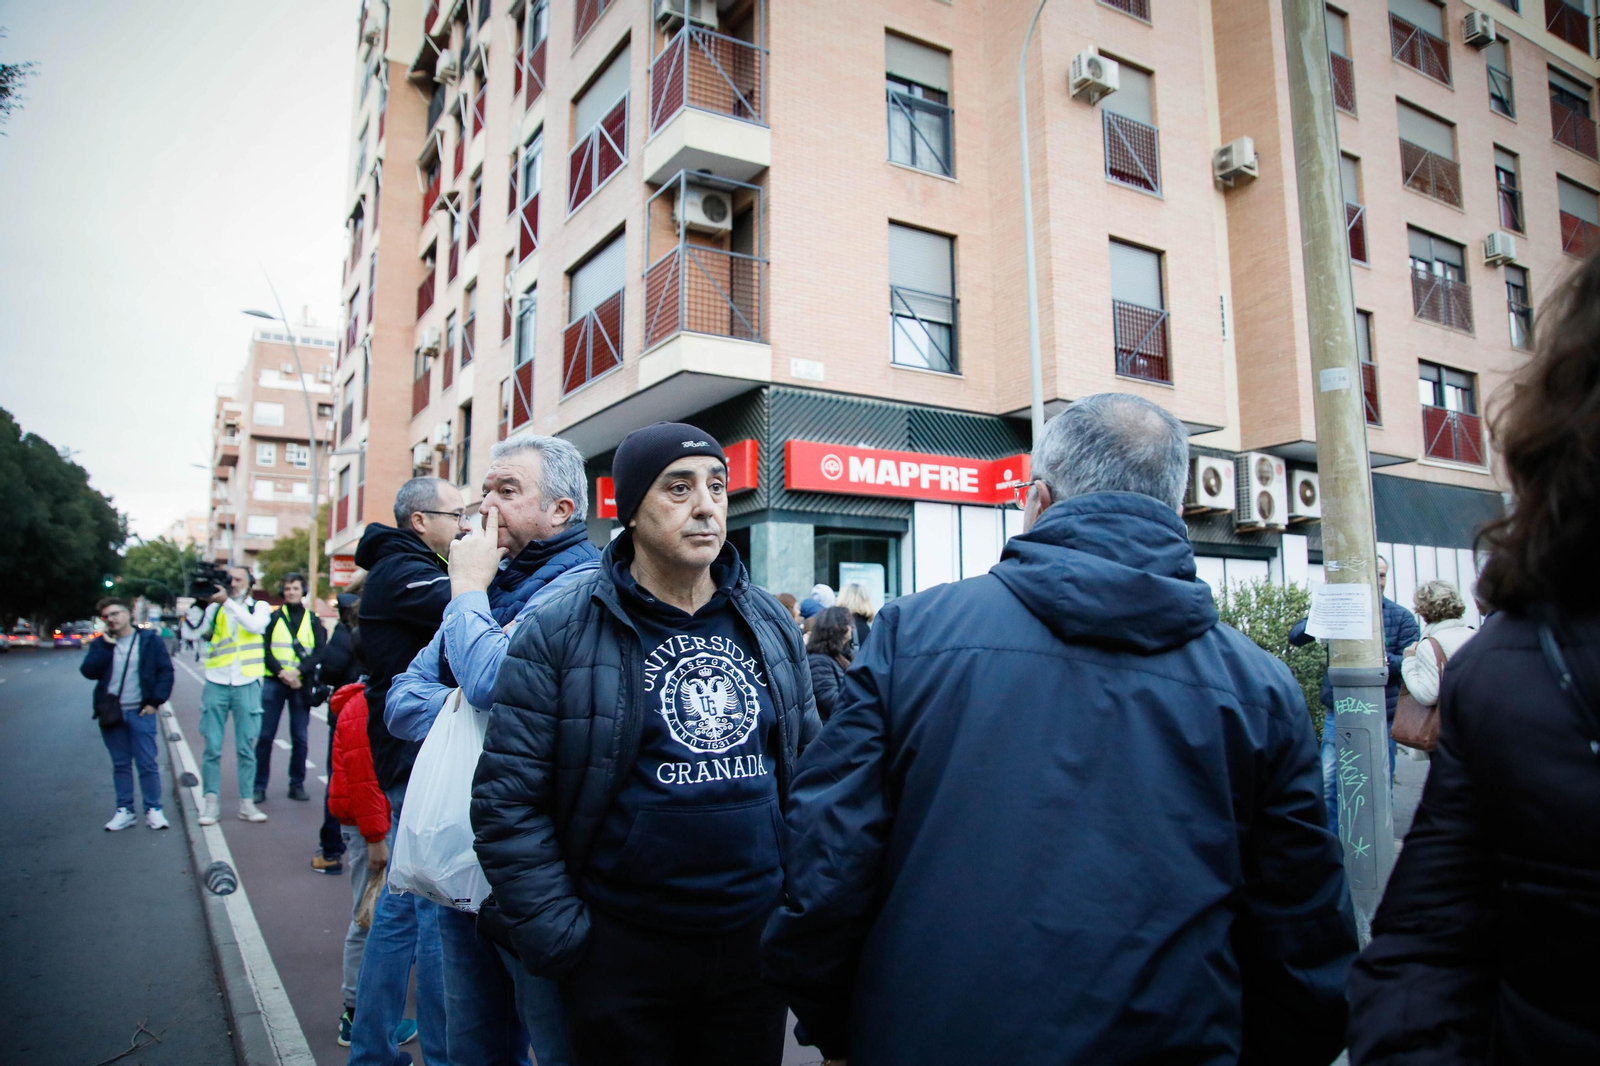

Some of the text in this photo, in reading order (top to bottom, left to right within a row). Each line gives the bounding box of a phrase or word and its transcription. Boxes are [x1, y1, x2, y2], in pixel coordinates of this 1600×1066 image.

[848, 456, 979, 493] MAPFRE
[707, 739, 731, 749] 1531
[656, 754, 768, 785] GRANADA
